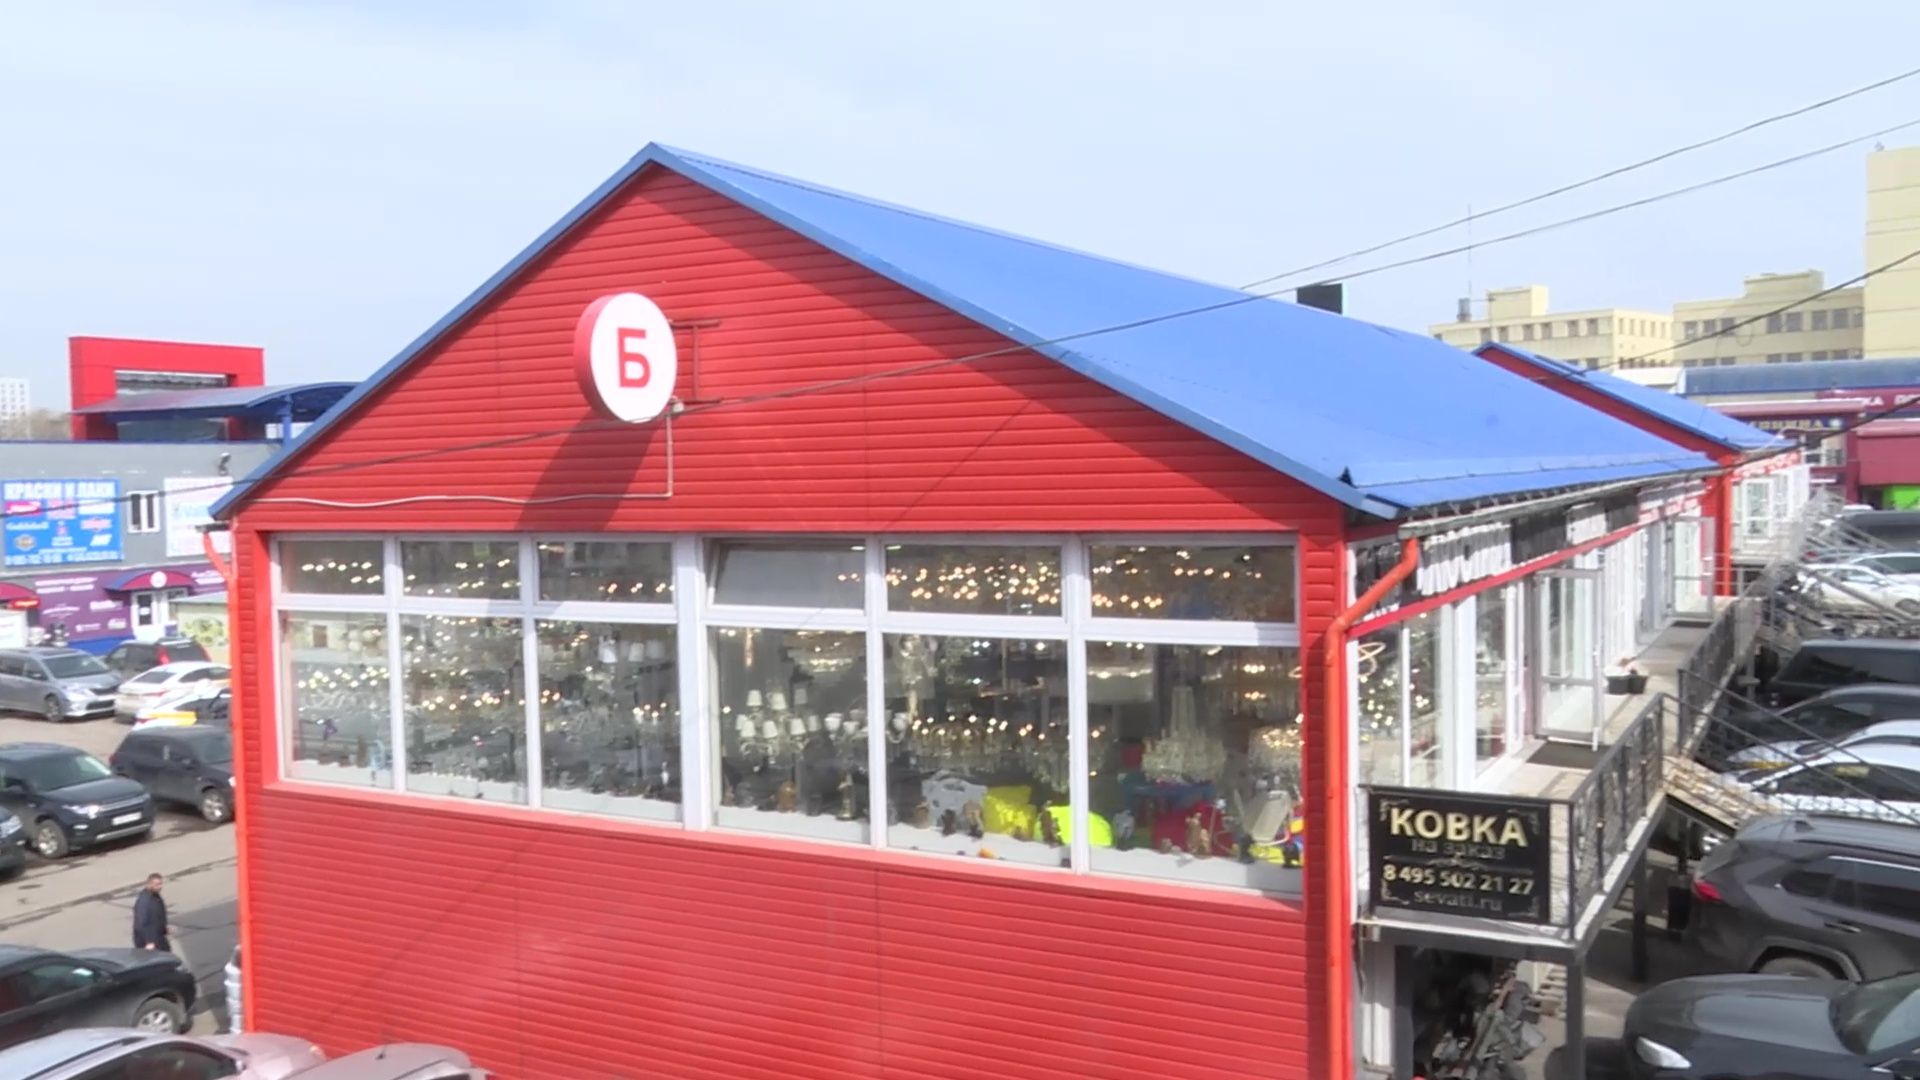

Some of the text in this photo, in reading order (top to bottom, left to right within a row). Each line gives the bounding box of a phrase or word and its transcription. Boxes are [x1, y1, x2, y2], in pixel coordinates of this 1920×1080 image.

[617, 327, 651, 388] Б
[1390, 807, 1528, 847] КОВКА
[1383, 864, 1535, 895] 8 495 502 21 27
